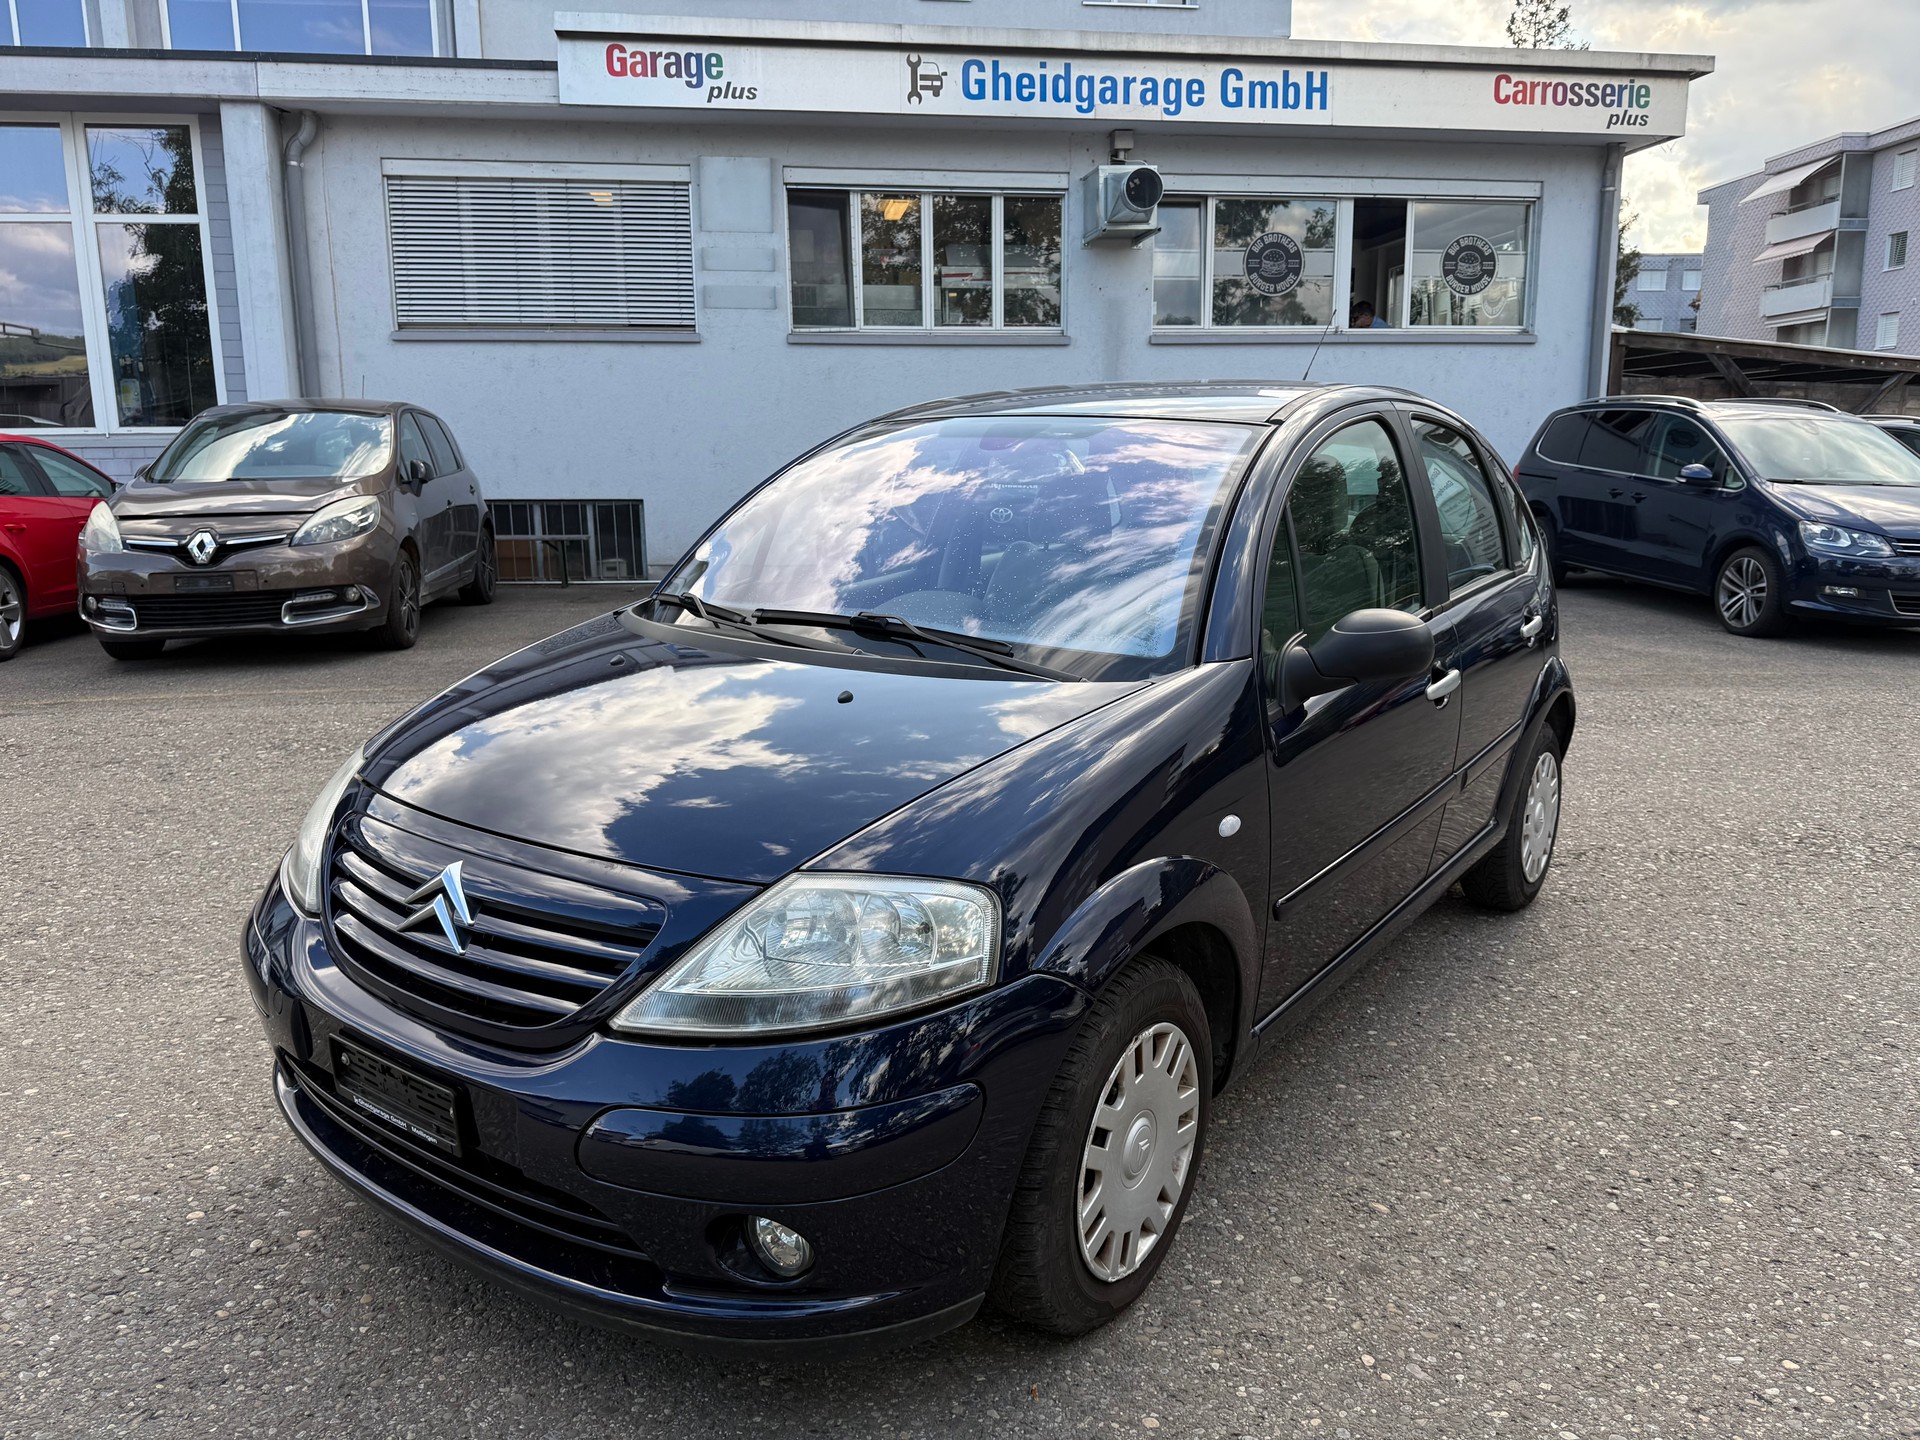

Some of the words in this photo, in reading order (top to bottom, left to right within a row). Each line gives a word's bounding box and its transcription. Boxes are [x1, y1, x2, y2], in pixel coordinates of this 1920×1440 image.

[605, 43, 724, 89] Garage
[706, 81, 758, 104] plus
[961, 58, 1206, 117] Gheidgarage
[1219, 67, 1329, 111] GmbH
[1493, 73, 1651, 109] Carrosserie
[1605, 109, 1650, 130] plus
[1251, 239, 1264, 253] BIG
[1263, 233, 1298, 254] BROTHERS
[1448, 242, 1460, 256] BIG
[1459, 236, 1492, 256] BROTHERS
[1249, 272, 1275, 293] BURGER
[1276, 272, 1298, 292] HOUSE
[1445, 274, 1470, 294] BURGER
[1471, 274, 1492, 293] HOUSE
